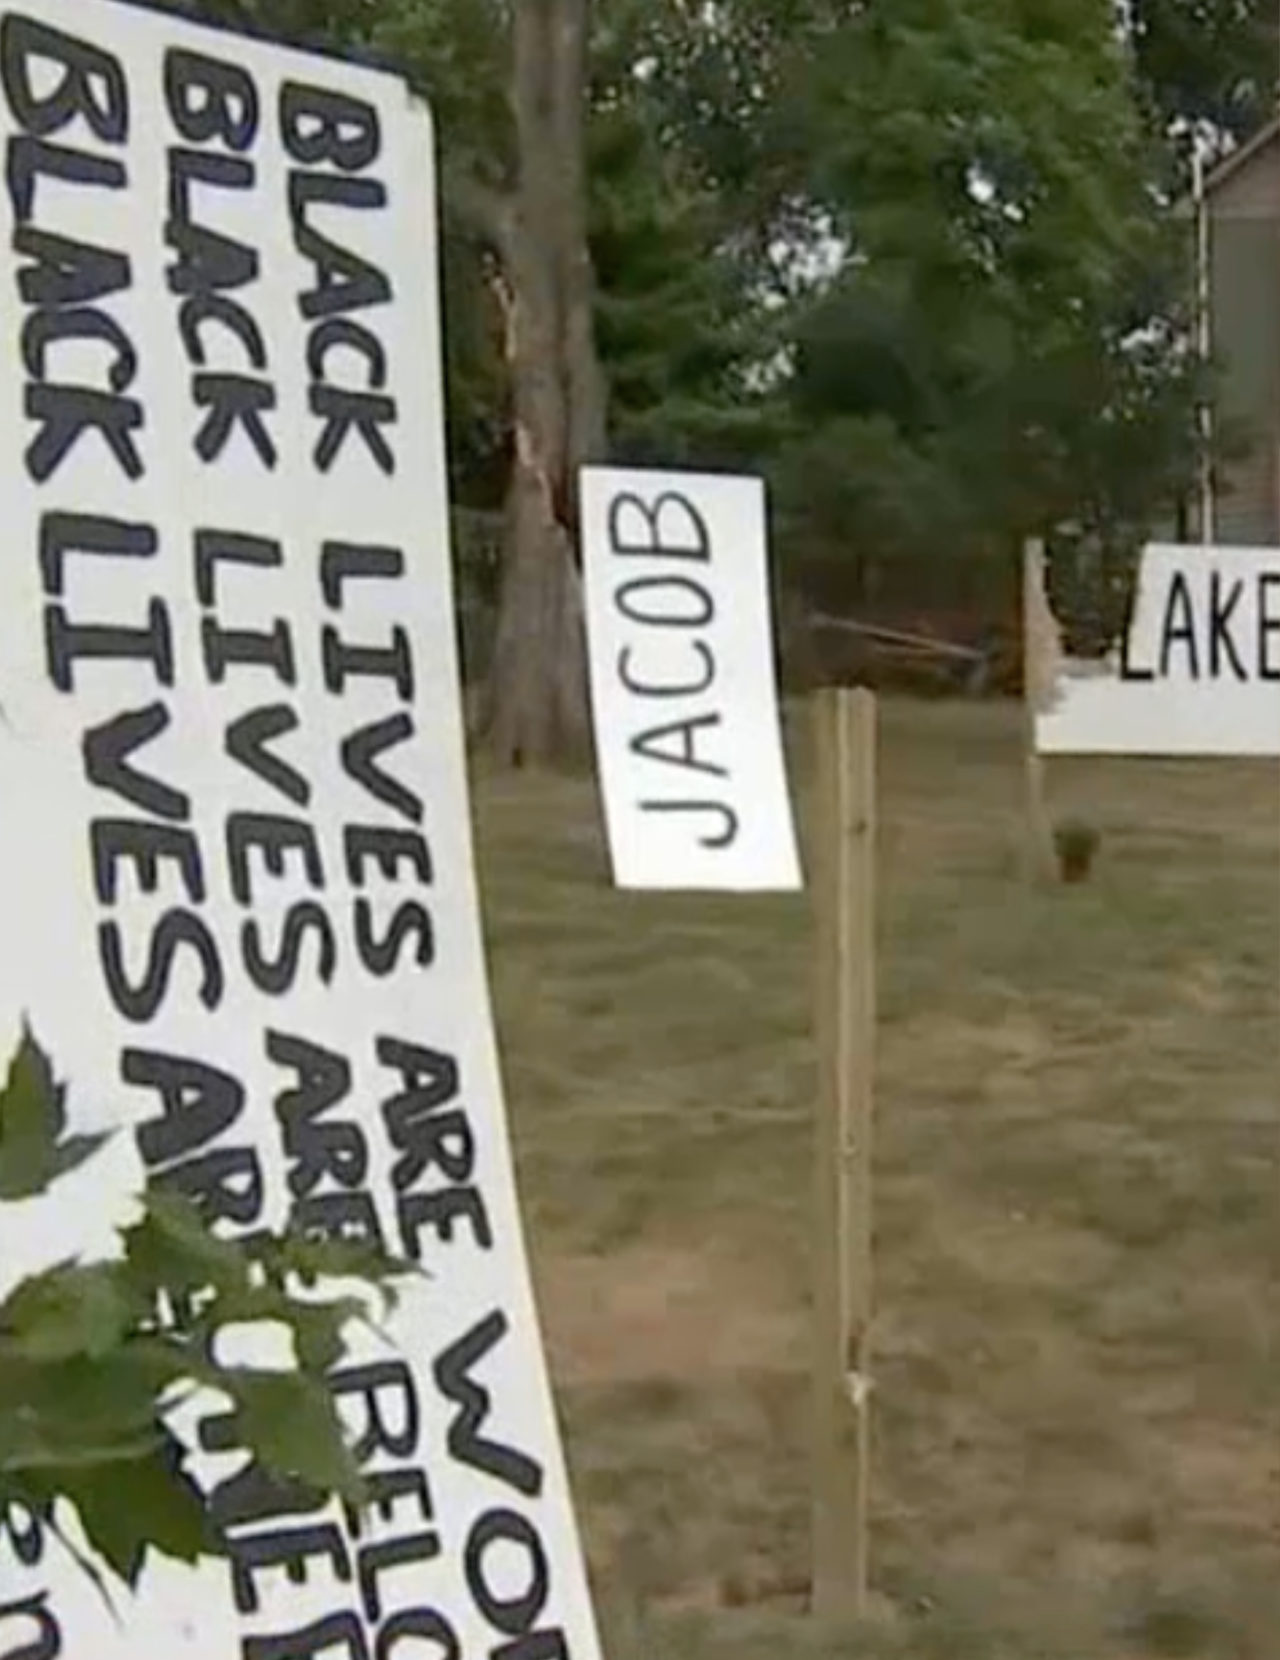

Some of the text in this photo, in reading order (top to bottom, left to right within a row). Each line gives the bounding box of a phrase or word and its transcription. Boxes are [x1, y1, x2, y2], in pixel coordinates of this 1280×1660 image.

[2, 10, 144, 485] BLACK
[163, 47, 277, 470] BLACK
[279, 79, 397, 475] BLACK
[38, 511, 224, 1025] LIVES
[193, 527, 337, 995] LIVES
[320, 541, 434, 976] LIVES
[608, 490, 739, 850] JACOB
[1118, 569, 1280, 682] LAKE
[120, 1047, 280, 1280] AR
[375, 1034, 492, 1259] ARE
